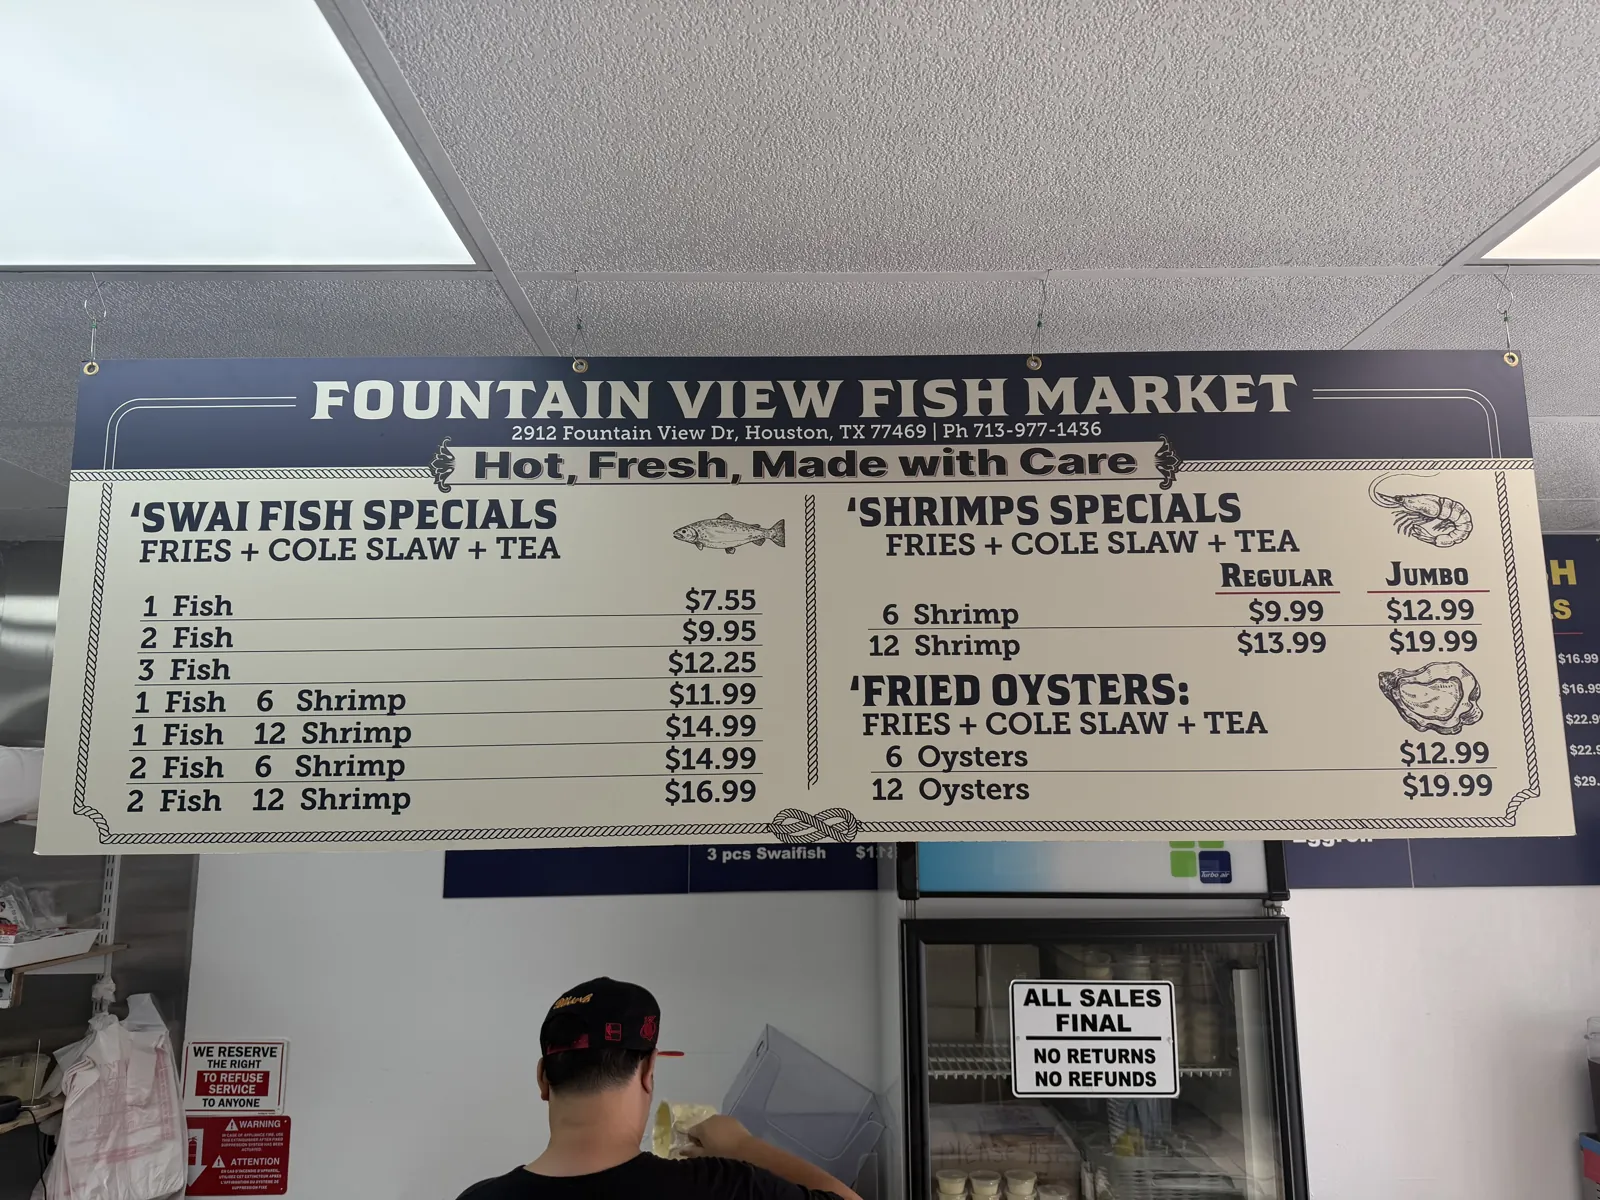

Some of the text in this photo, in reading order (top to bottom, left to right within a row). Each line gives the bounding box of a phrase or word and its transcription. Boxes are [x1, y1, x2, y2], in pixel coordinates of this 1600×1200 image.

[311, 375, 1297, 419] FOUNTAIN VIEW FISH MARKET
[512, 426, 556, 440] 2912
[563, 426, 652, 440] Fountain
[657, 426, 705, 440] View
[712, 426, 738, 441] Dr,
[746, 426, 833, 441] Houston,
[840, 425, 865, 438] TX
[871, 424, 926, 438] 77469
[943, 424, 968, 438] Ph
[974, 422, 1101, 437] 713-977-1436
[475, 447, 1137, 485] Hot, Fresh, Made with Care
[258, 500, 353, 531] FISH
[363, 499, 556, 530] SPECIALS
[1050, 493, 1240, 525] SPECIALS
[139, 539, 231, 562] FRIES
[269, 538, 356, 561] COLE
[367, 537, 460, 560] SLAW
[496, 537, 560, 559] TEA
[886, 533, 975, 556] FRIES
[1012, 532, 1098, 555] COLE
[1108, 531, 1198, 554] SLAW
[1234, 530, 1300, 552] TEA
[1546, 559, 1577, 585] H
[144, 587, 758, 616] 1 Fish $7.55
[883, 597, 1476, 629] 6 Shrimp $9.99 $12.99
[1550, 599, 1572, 620] S
[141, 618, 758, 648] 2 Fish $9.95
[870, 628, 1477, 660] 12 Shrimp $13.99 $19.99
[138, 650, 758, 681] 3 Fish $12.25
[1558, 653, 1599, 665] $16.99
[136, 681, 756, 716] 1 Fish 6 Shrimp $11.99
[992, 674, 1189, 706] OYSTERS:
[1562, 683, 1600, 695] $16.99
[133, 713, 756, 749] 1 Fish 12 Shrimp $14.99
[863, 713, 950, 735] FRIES
[986, 712, 1071, 735] COLE
[1080, 712, 1168, 735] SLAW
[1204, 711, 1268, 734] TEA
[1566, 713, 1600, 726] $22.9
[130, 746, 756, 782] 2 Fish 6 Shrimp $14.99
[886, 740, 1491, 772] 6 Oysters $12.99
[127, 778, 756, 815] 2 Fish 12 Shrimp $16.99
[873, 773, 1492, 804] 12 Oysters $19.99
[707, 848, 717, 860] 3
[722, 848, 751, 863] pcs
[756, 847, 826, 859] Swaifish
[1024, 989, 1161, 1007] ALL SALES
[1057, 1014, 1131, 1032] FINAL
[193, 1047, 277, 1057] WE RESERVE
[207, 1060, 262, 1068] THE RIGHT
[1034, 1048, 1155, 1064] NO RETURNS
[203, 1073, 263, 1083] TO REFUSE
[209, 1084, 256, 1094] SERVICE
[1036, 1071, 1156, 1087] NO REFUNDS
[202, 1099, 260, 1107] TO ANYONE
